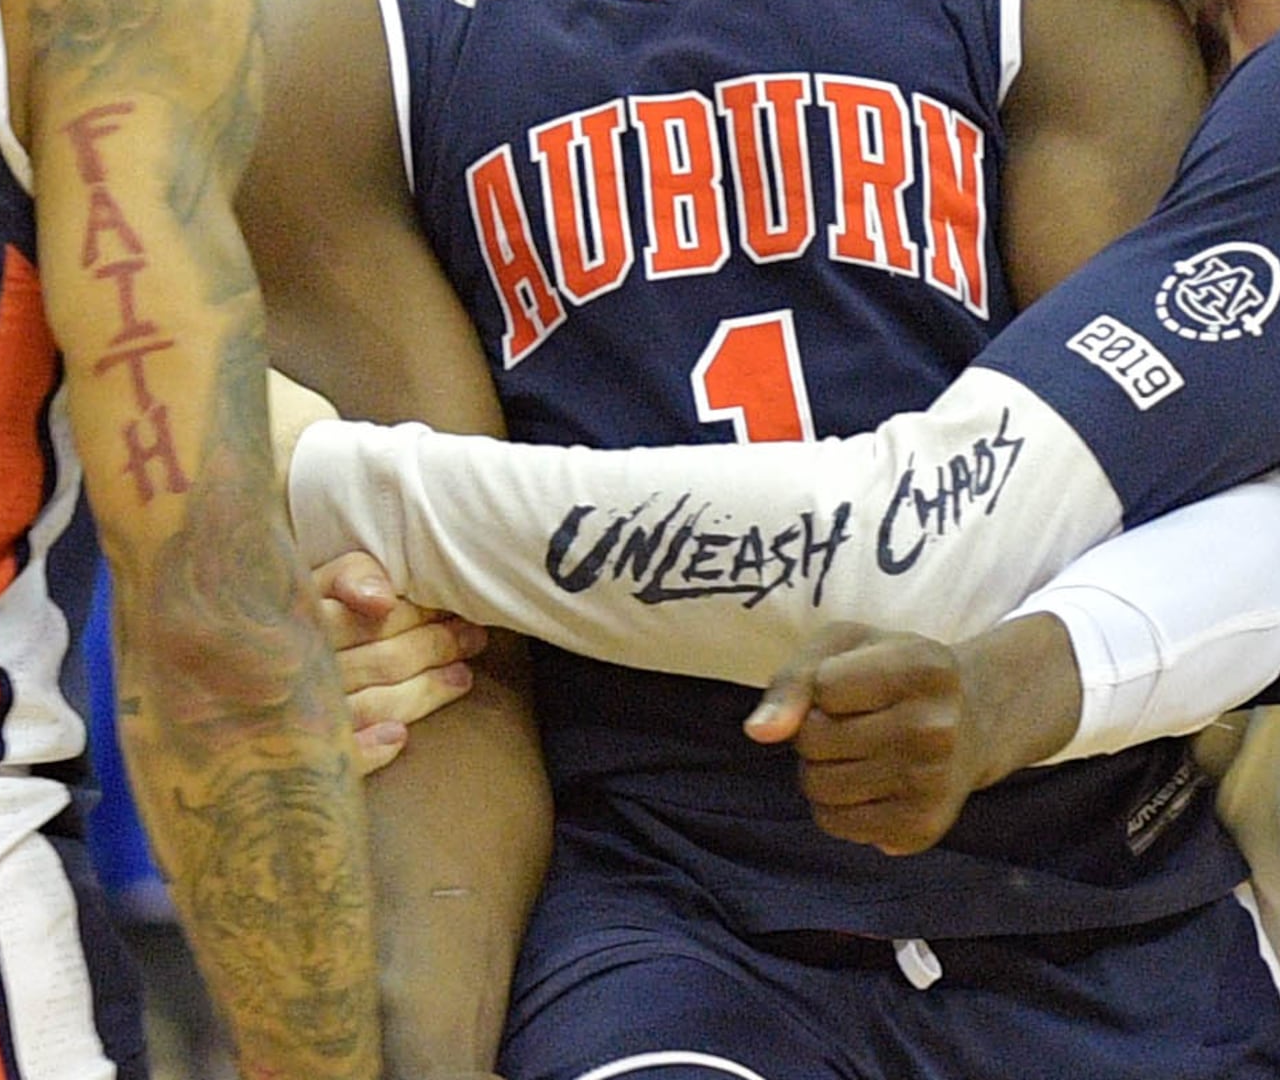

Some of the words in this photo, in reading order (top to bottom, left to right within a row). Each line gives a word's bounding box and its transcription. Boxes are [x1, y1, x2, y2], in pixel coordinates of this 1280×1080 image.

[61, 100, 192, 508] FAITH
[466, 72, 990, 371] AUBURN
[691, 310, 818, 444] 1
[1076, 323, 1171, 399] 2019
